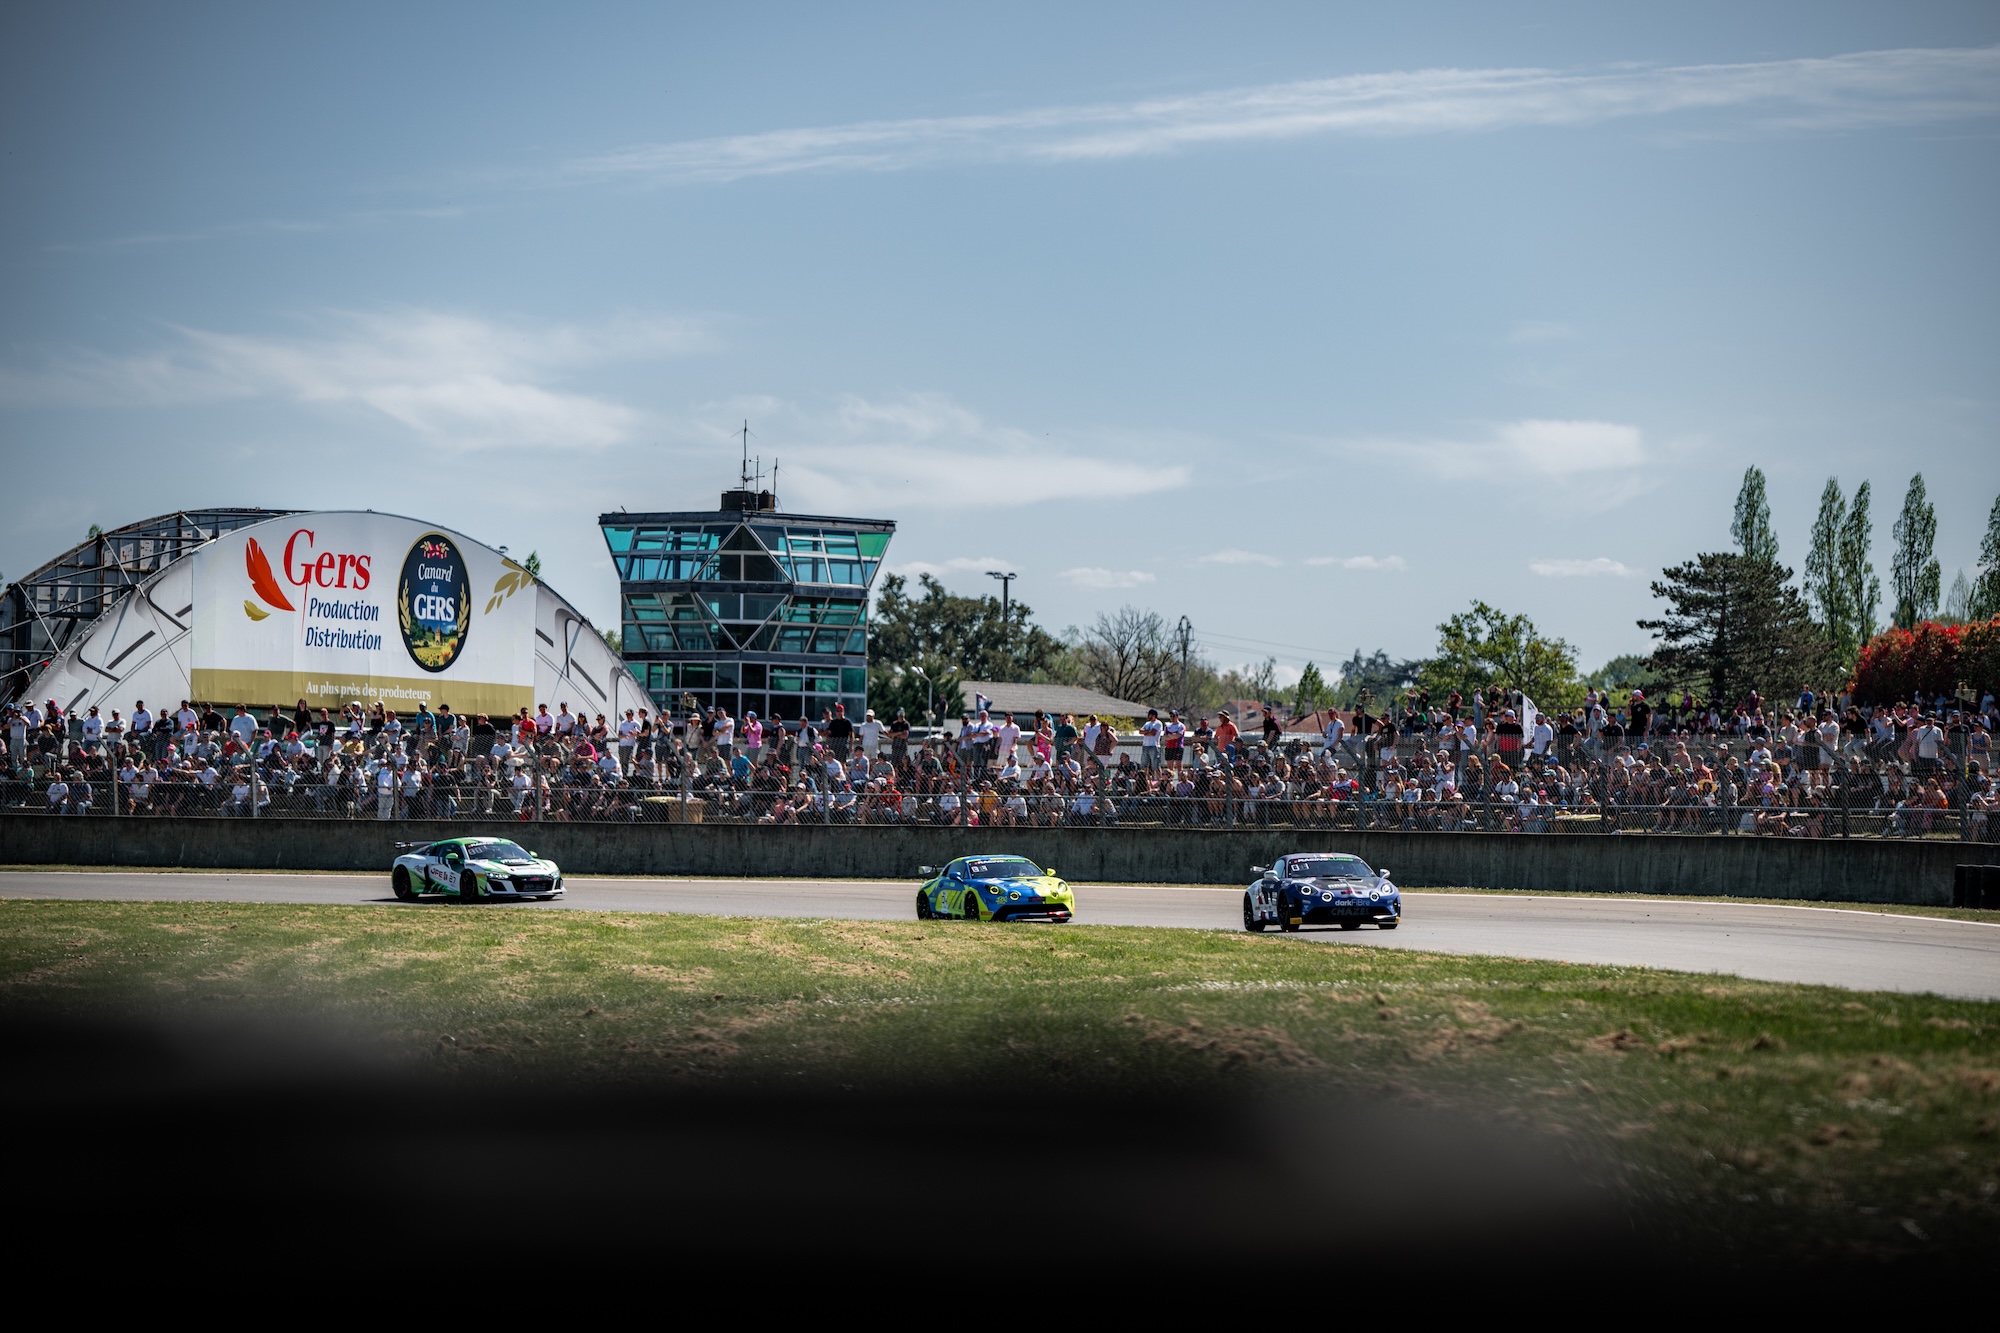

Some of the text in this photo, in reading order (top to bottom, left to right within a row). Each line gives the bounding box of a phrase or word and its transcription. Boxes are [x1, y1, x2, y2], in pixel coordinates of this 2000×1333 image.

[283, 529, 371, 590] Gers
[418, 563, 453, 582] Canard
[430, 581, 439, 593] du
[309, 597, 379, 621] Production
[413, 593, 455, 622] GERS
[305, 626, 382, 650] Distribution
[306, 681, 431, 700] Au plus près des producteurs
